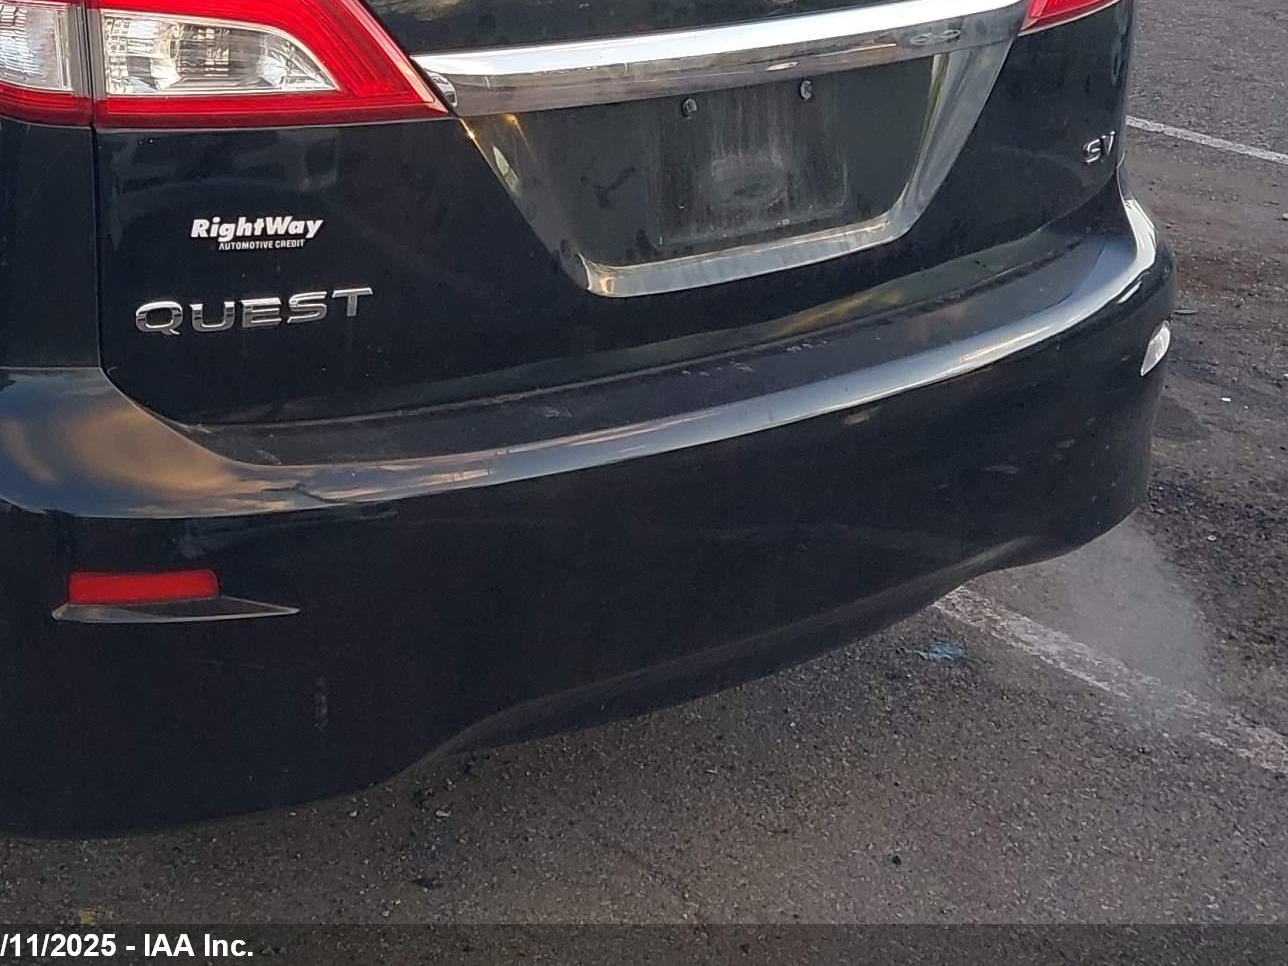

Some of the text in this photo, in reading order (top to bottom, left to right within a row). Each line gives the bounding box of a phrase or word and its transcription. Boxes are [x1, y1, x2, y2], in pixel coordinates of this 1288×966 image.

[190, 216, 324, 242] RightWay
[218, 238, 306, 251] AUTOMOTIVE CREDIT
[135, 287, 374, 335] QUEST
